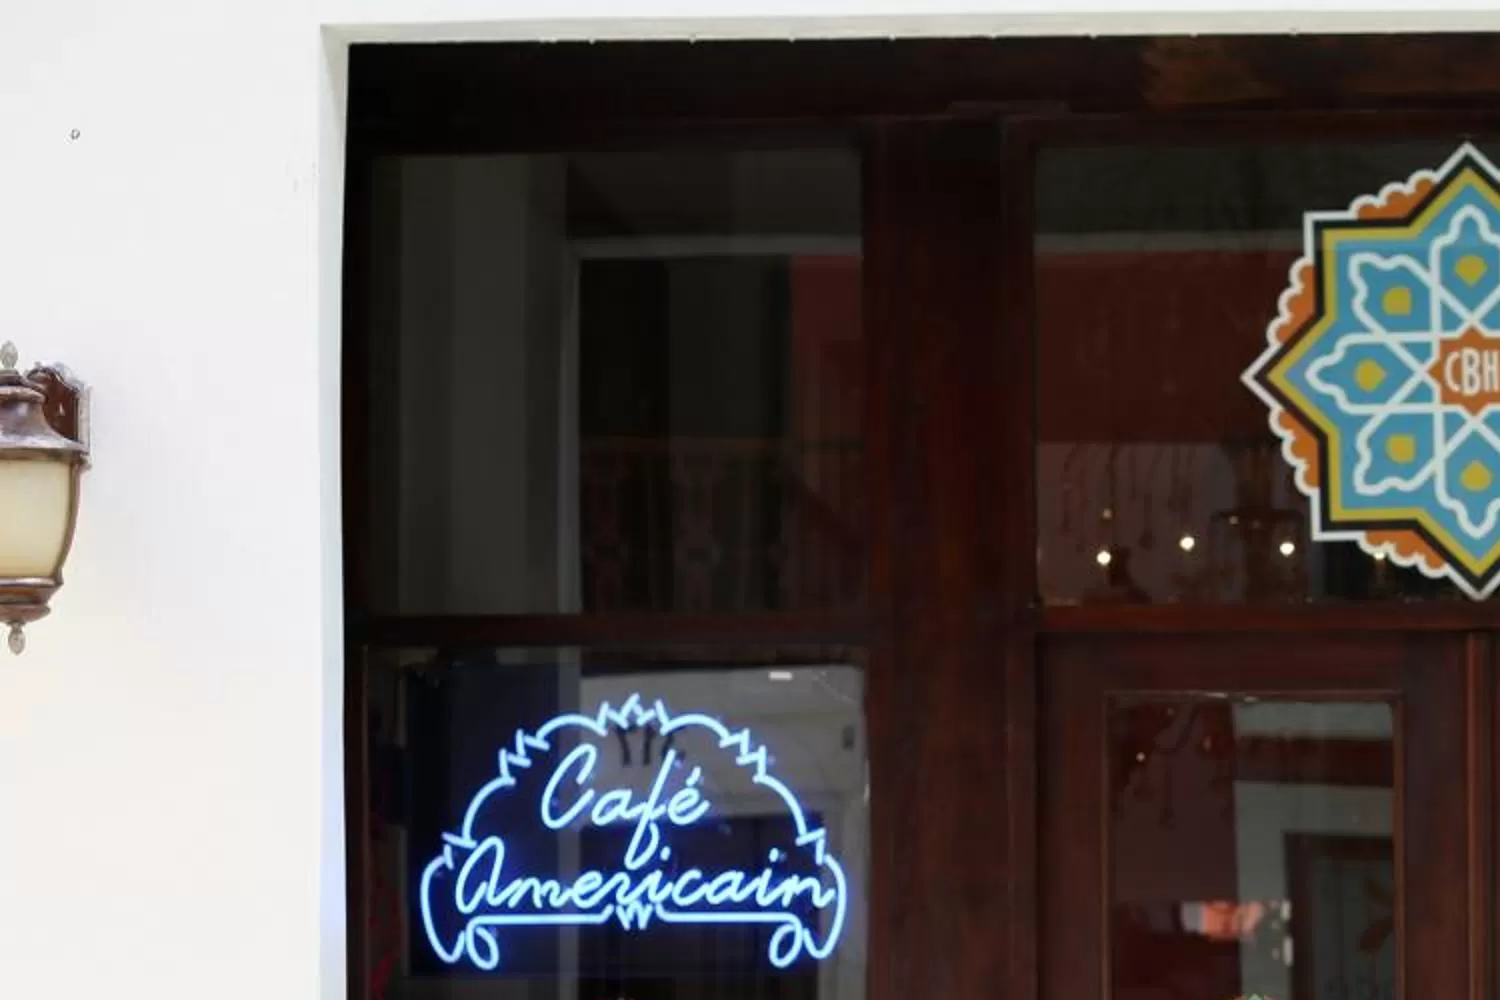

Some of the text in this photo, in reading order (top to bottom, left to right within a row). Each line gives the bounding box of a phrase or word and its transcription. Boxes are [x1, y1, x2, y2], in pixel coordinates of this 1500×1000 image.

[1444, 347, 1500, 397] CBH
[541, 743, 710, 869] Café
[455, 836, 837, 914] Americain
